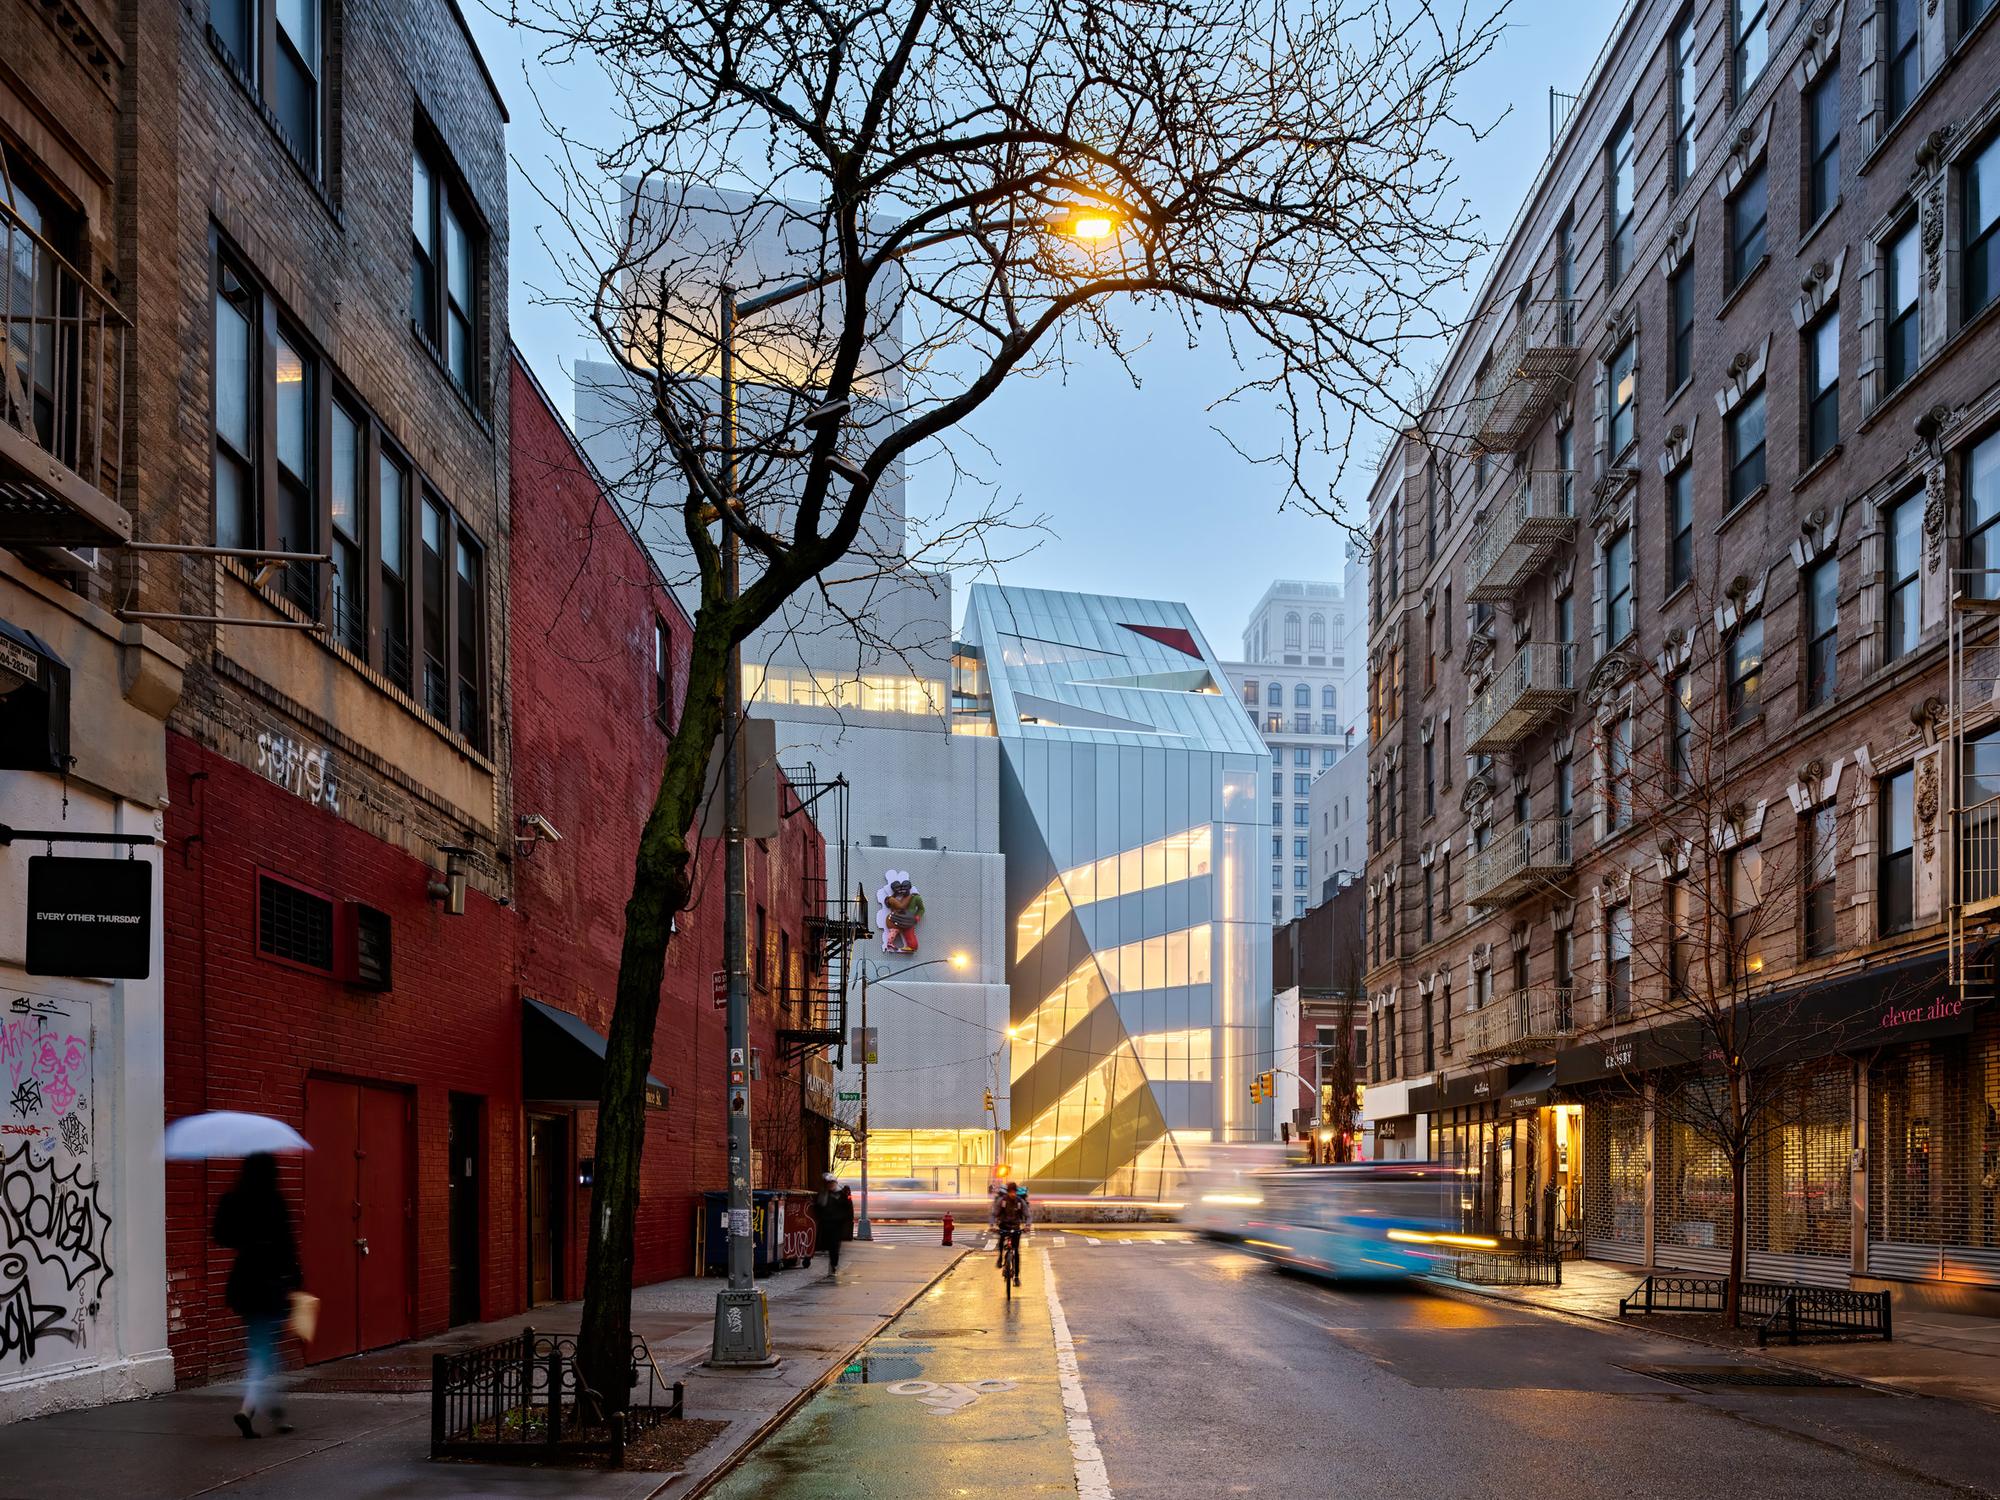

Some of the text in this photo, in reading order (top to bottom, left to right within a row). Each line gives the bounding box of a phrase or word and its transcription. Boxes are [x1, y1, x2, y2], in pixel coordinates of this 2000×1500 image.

[9, 642, 22, 655] IRON
[22, 648, 37, 662] WORK
[36, 911, 141, 924] EVERY OTHER THURSDAY
[714, 975, 722, 983] NO
[1881, 996, 1962, 1028] clever alice
[1509, 1096, 1537, 1109] 2 Prince Street
